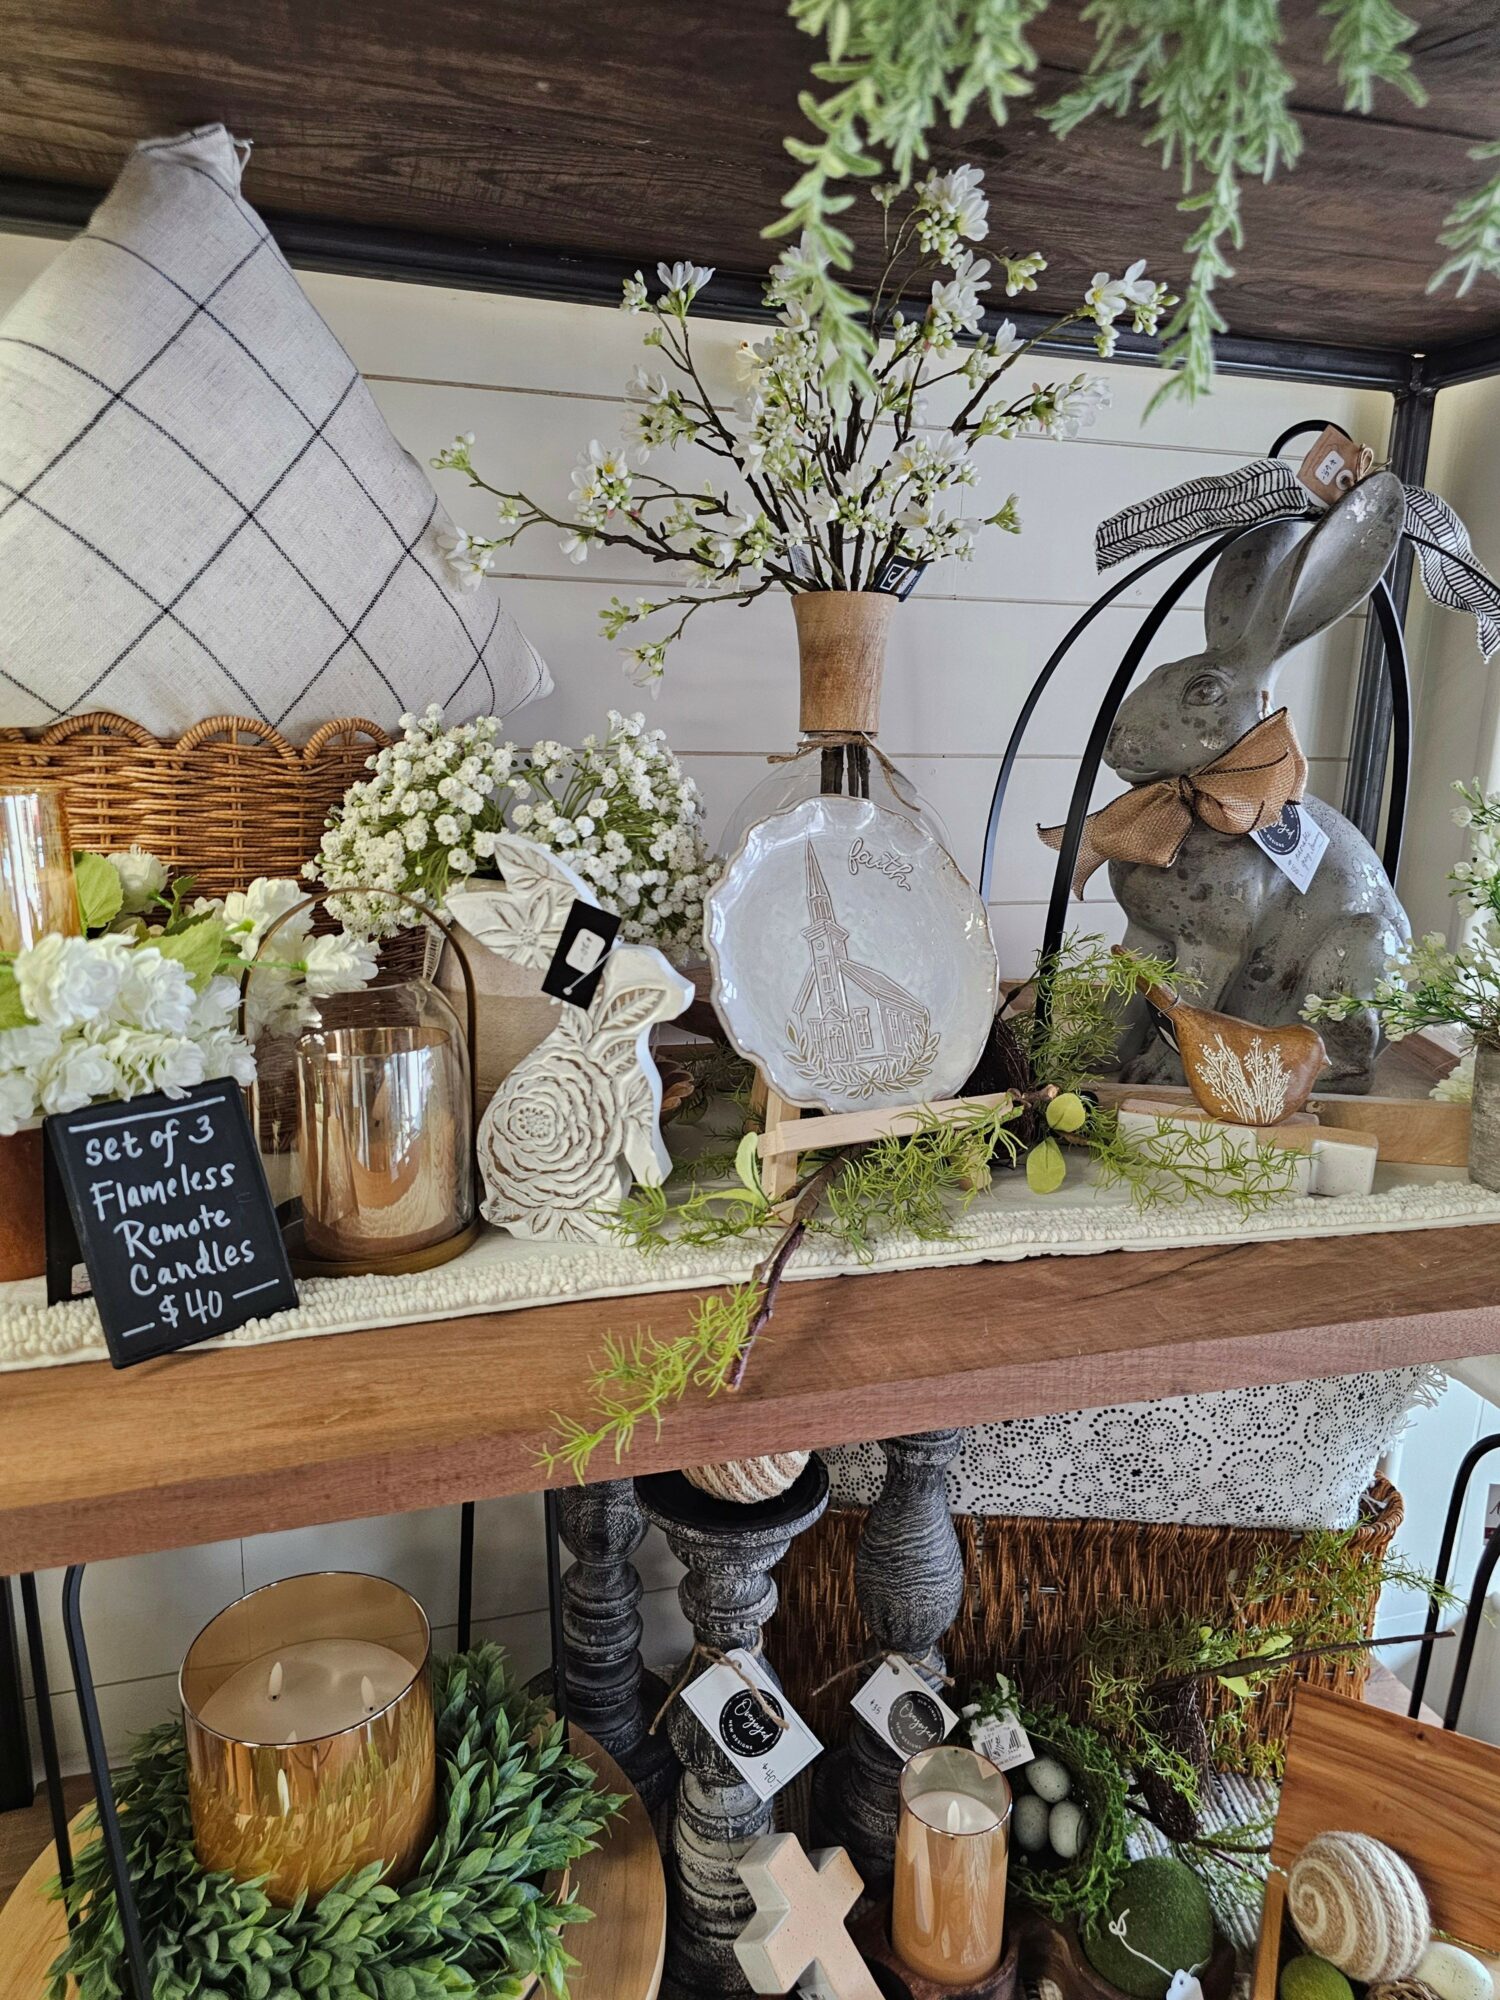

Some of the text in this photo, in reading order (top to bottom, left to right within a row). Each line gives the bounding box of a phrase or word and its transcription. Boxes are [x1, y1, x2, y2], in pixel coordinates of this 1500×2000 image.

[848, 837, 914, 892] faith
[85, 1114, 215, 1168] set of 3
[89, 1163, 236, 1221] Flameless
[113, 1204, 232, 1259] Remote
[130, 1239, 256, 1296] Candles
[732, 1734, 753, 1751] DESIGNS
[734, 1698, 774, 1743] Overjoyed
[899, 1700, 939, 1742] Overjoyed
[901, 1734, 923, 1750] DESIGNS
